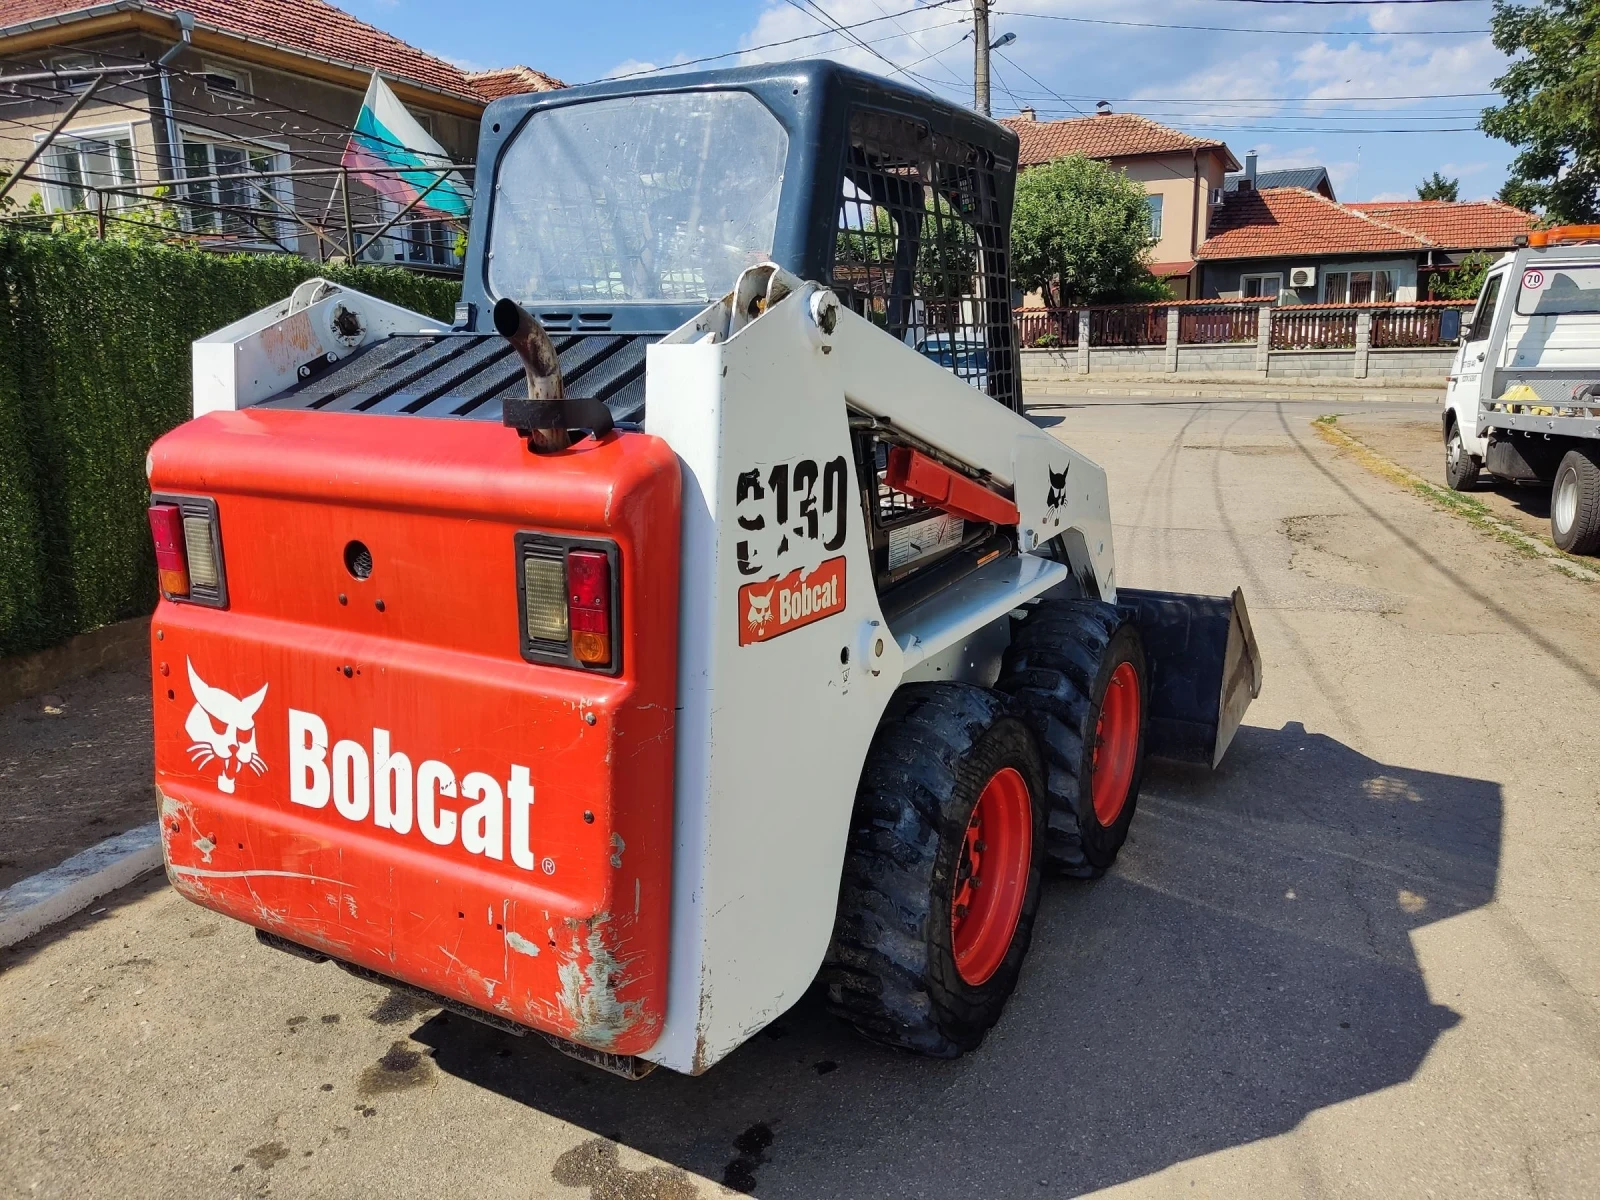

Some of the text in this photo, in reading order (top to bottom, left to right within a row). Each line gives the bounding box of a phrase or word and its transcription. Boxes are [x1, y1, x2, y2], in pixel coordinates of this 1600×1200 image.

[1527, 274, 1541, 284] 70
[779, 574, 838, 625] Bobcat
[289, 708, 535, 871] Bobcat
